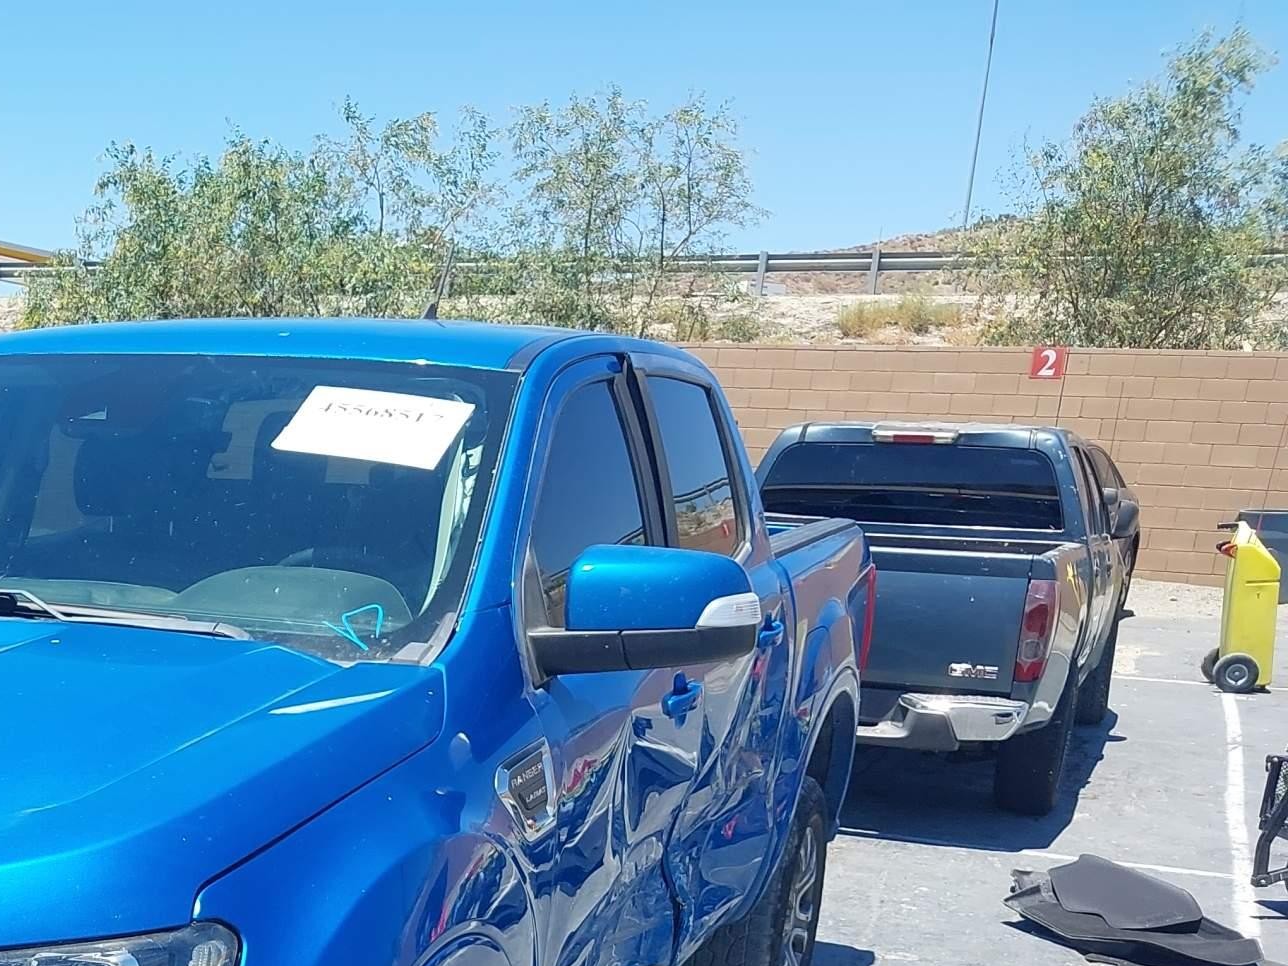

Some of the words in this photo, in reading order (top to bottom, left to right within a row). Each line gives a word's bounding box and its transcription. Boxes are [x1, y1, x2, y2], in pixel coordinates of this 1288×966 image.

[1037, 349, 1057, 376] 2
[948, 662, 999, 680] GMC
[511, 762, 543, 789] RANGER
